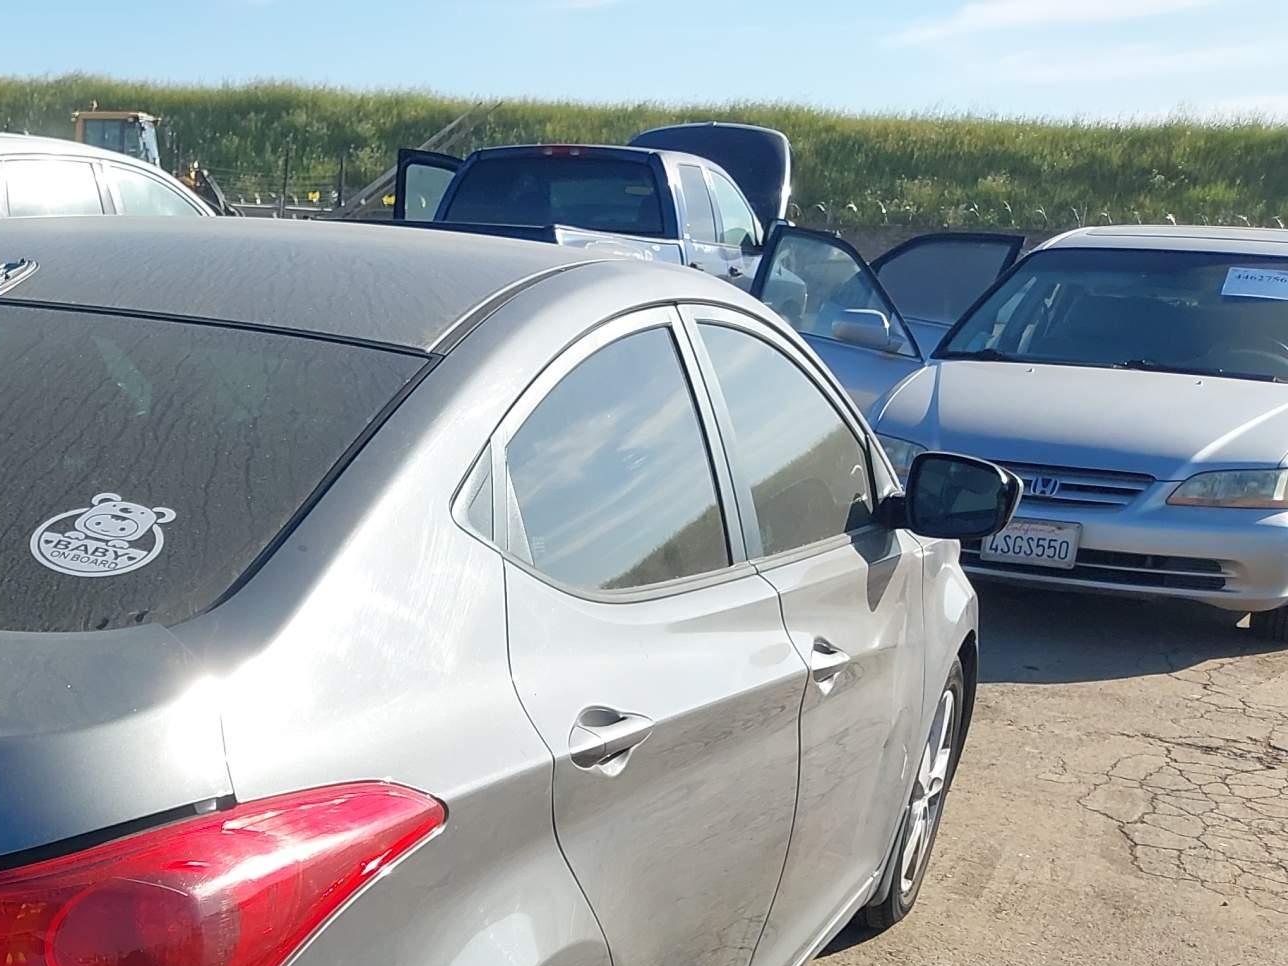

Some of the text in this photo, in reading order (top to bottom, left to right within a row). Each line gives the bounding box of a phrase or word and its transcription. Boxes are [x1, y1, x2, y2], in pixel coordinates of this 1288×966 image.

[53, 539, 130, 561] BABY
[988, 534, 1070, 560] 4SGS550
[50, 550, 119, 570] ON BOARD
